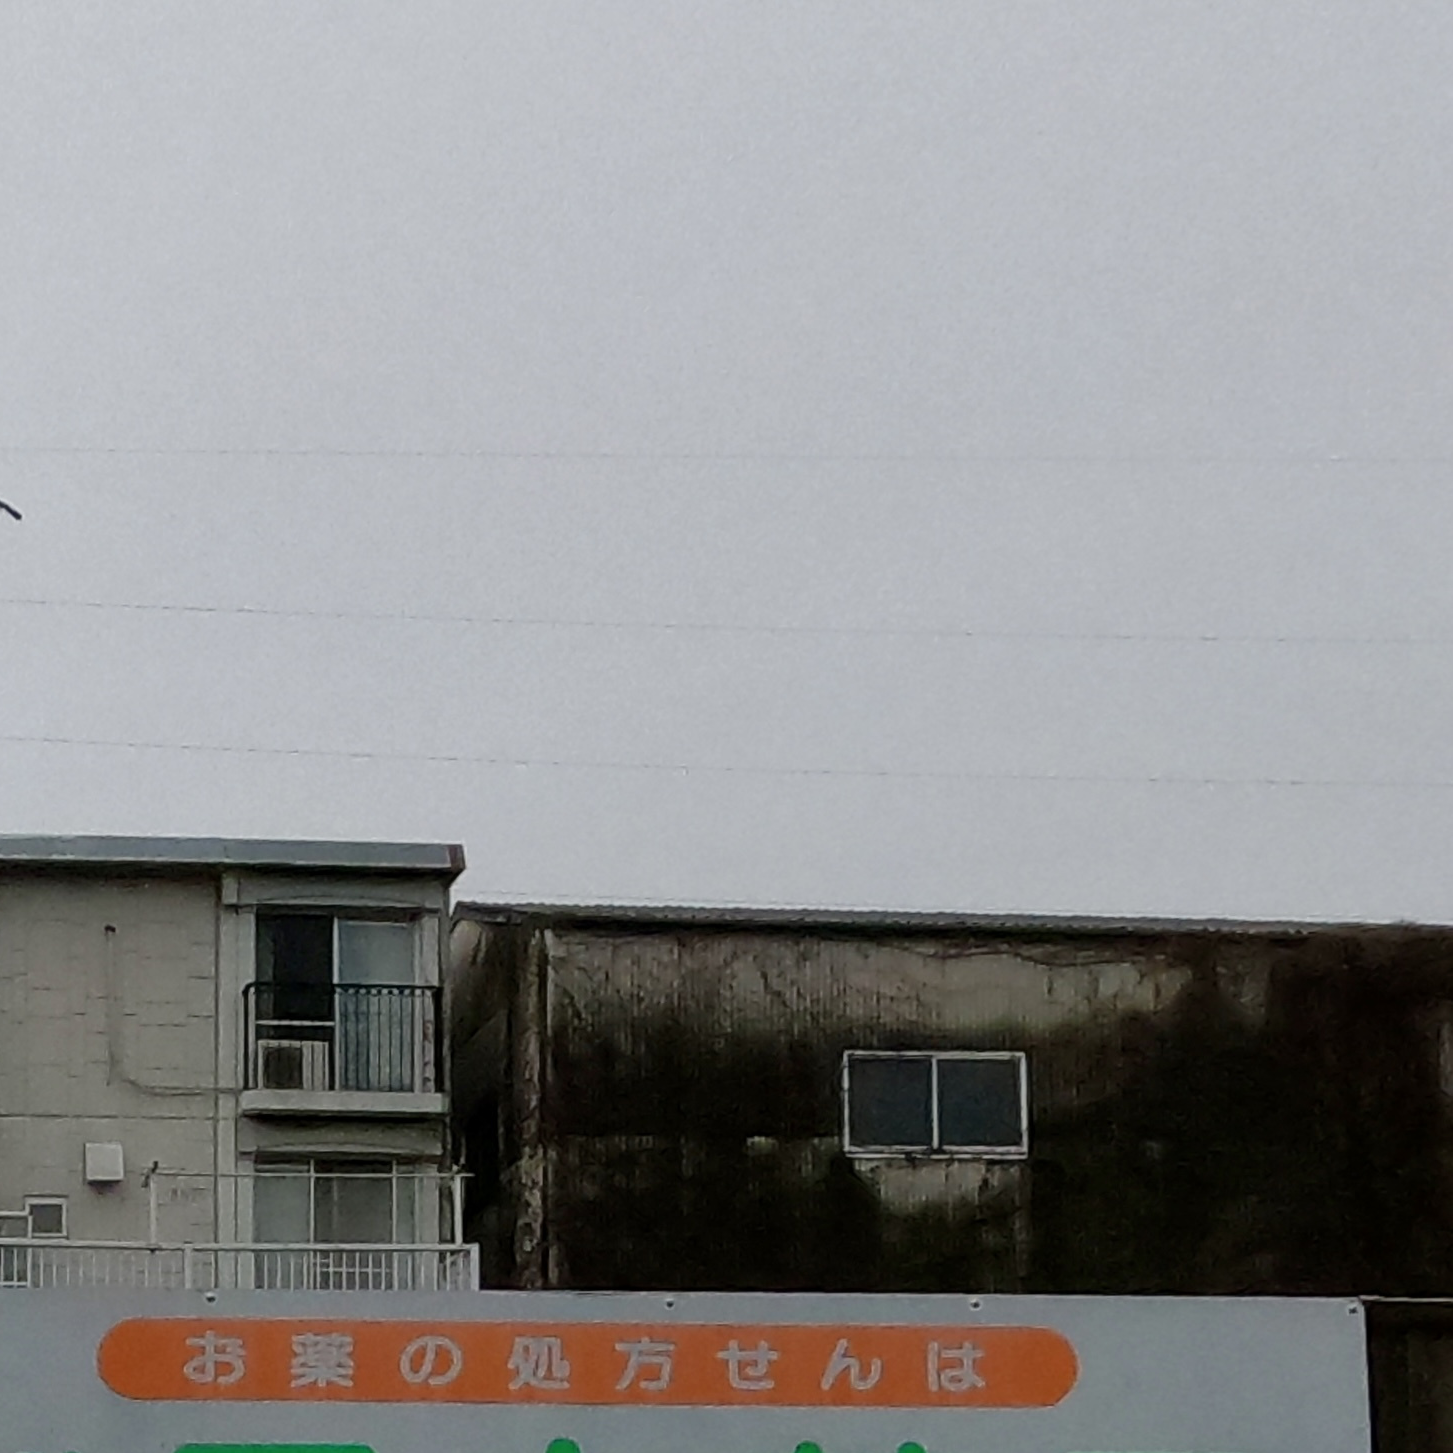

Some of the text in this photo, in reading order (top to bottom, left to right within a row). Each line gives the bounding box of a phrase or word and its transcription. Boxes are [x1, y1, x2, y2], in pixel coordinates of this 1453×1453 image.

[182, 1331, 986, 1393] お薬の処方せんは
